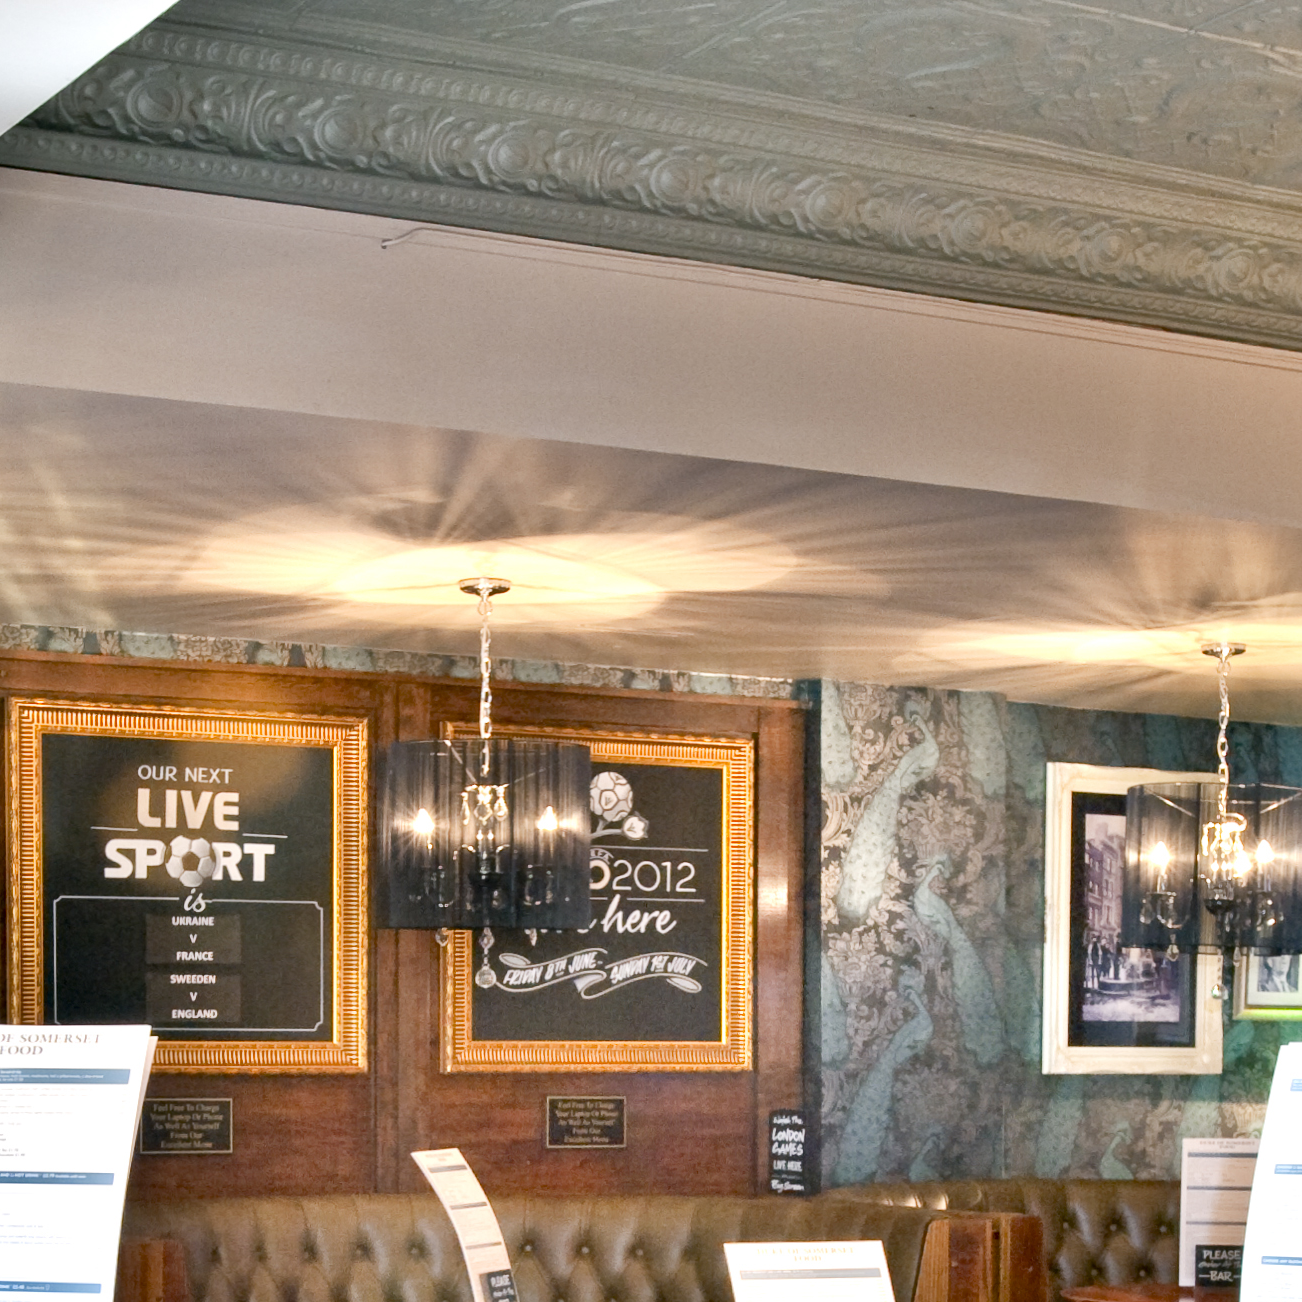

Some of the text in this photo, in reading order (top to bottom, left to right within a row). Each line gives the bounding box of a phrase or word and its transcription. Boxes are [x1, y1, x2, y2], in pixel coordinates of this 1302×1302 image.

[137, 764, 233, 784] OUR NEXT
[137, 788, 240, 831] LIVE
[104, 837, 275, 887] SPORT
[184, 888, 212, 912] is
[601, 894, 677, 934] here
[171, 916, 215, 927] UKRAINE
[189, 934, 198, 944] V
[176, 951, 214, 961] FRANCE
[503, 965, 543, 986] FRIDAY
[610, 956, 649, 984] SUNDAY
[667, 957, 696, 975] JULY
[170, 974, 216, 984] SWEEDEN
[189, 991, 198, 1001] V
[171, 1008, 218, 1019] ENGLAND
[18, 1033, 100, 1044] SOMERSET
[0, 1045, 44, 1055] FOOD
[771, 1127, 805, 1143] LONDON
[771, 1141, 804, 1156] GAMES
[1203, 1249, 1241, 1260] PLEASE
[1210, 1270, 1233, 1282] BAR
